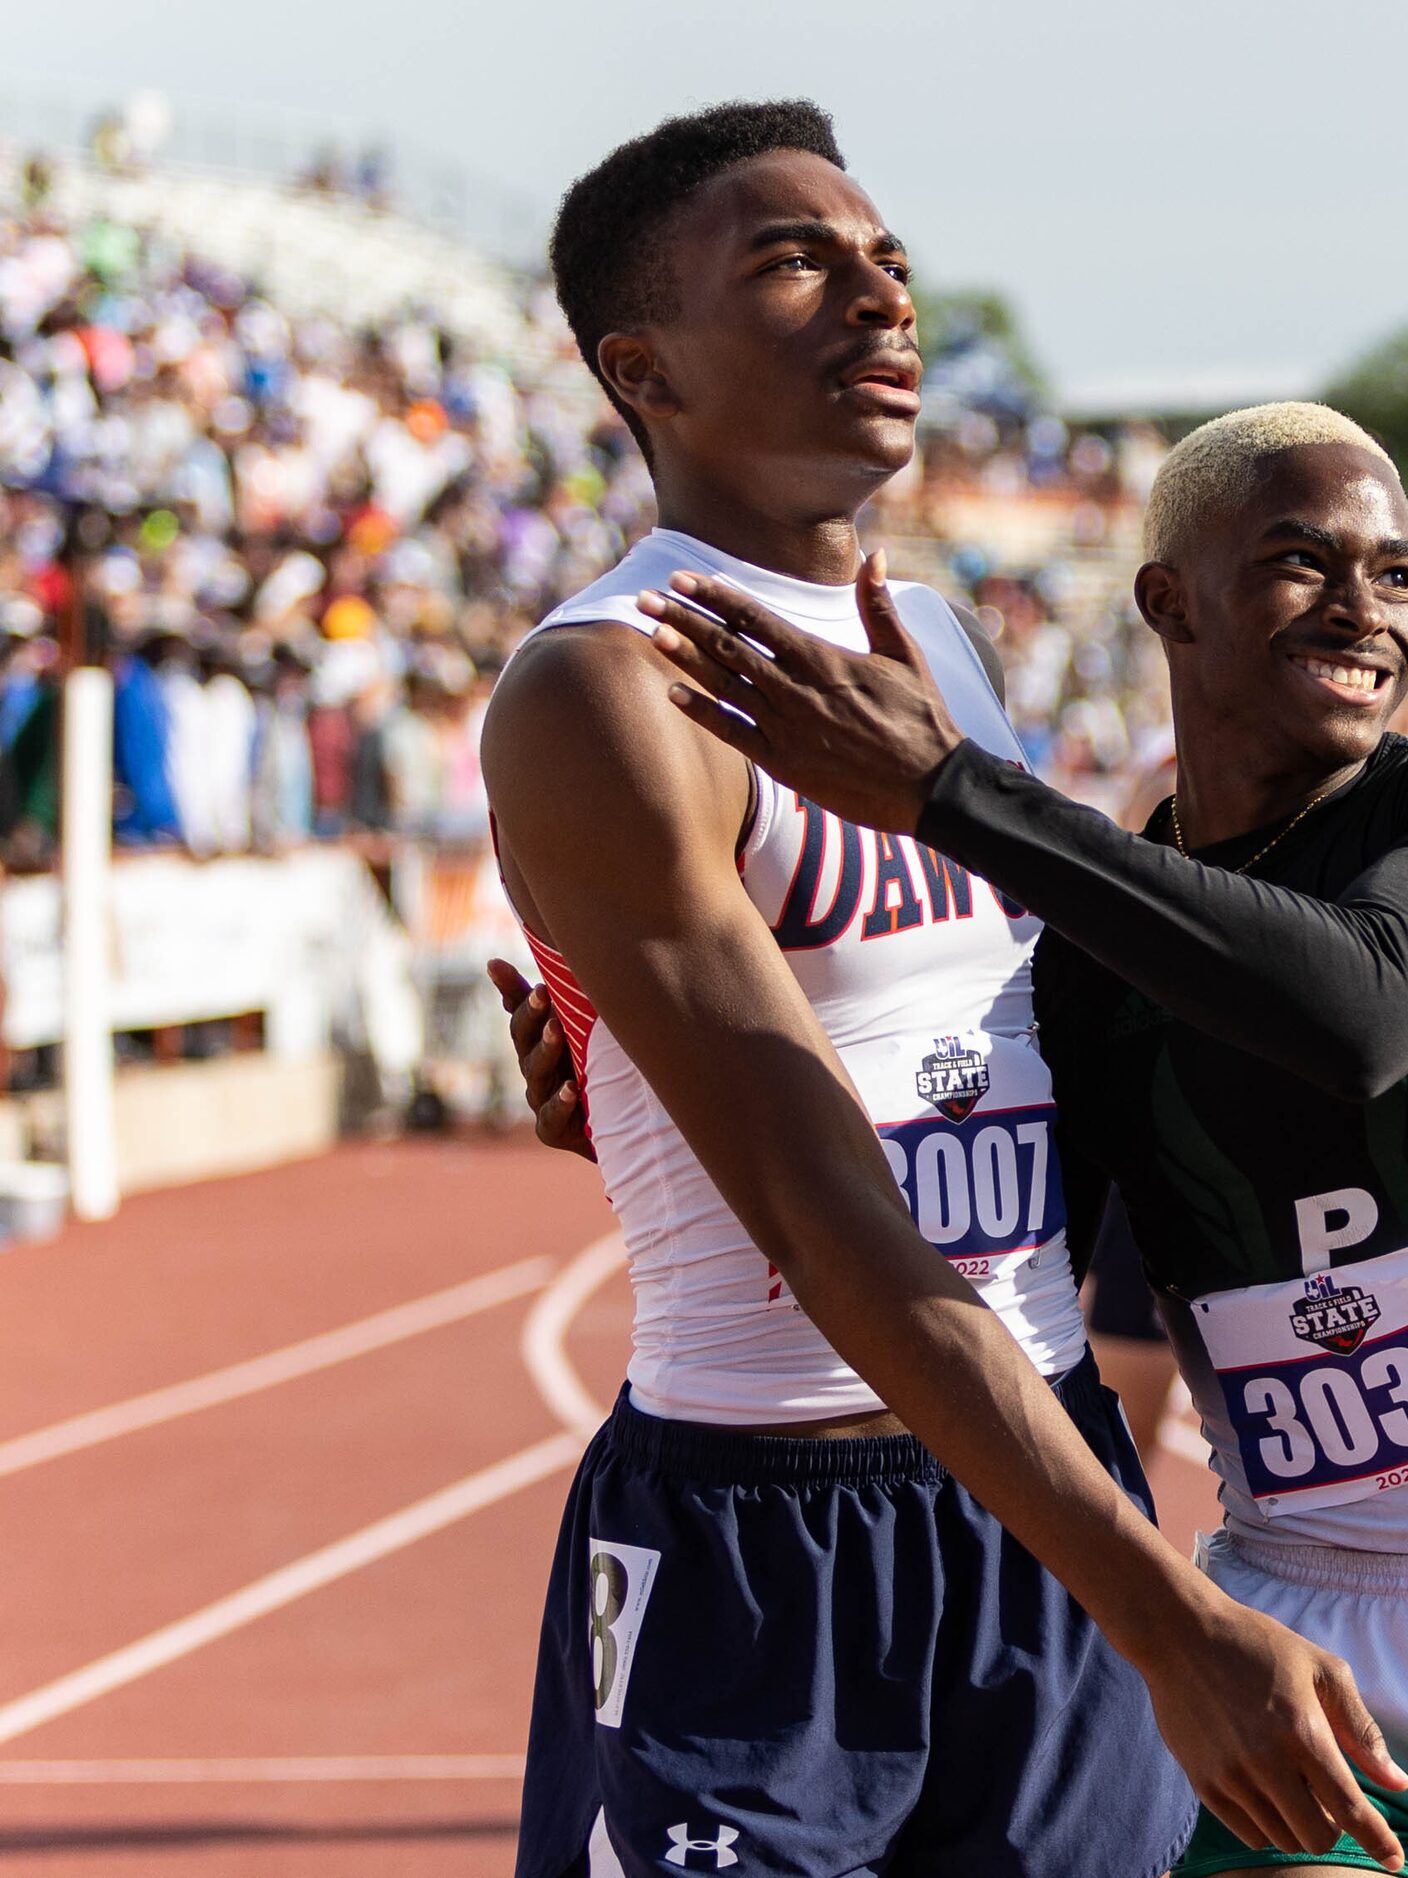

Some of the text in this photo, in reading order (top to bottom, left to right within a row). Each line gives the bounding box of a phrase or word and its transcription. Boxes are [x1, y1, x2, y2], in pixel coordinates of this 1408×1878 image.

[933, 1061, 953, 1070] TRACK
[958, 1059, 973, 1068] FIELD
[917, 1065, 989, 1094] STATE
[933, 1089, 978, 1101] CHAMPIONSHIPS
[1294, 1187, 1379, 1277] P
[953, 1259, 989, 1275] 022
[1305, 1302, 1328, 1312] TRACK
[1333, 1296, 1352, 1306] FIELD
[1292, 1296, 1379, 1335] STATE
[1313, 1320, 1366, 1339] CHAMPIONSHIPS
[591, 1551, 629, 1711] 8
